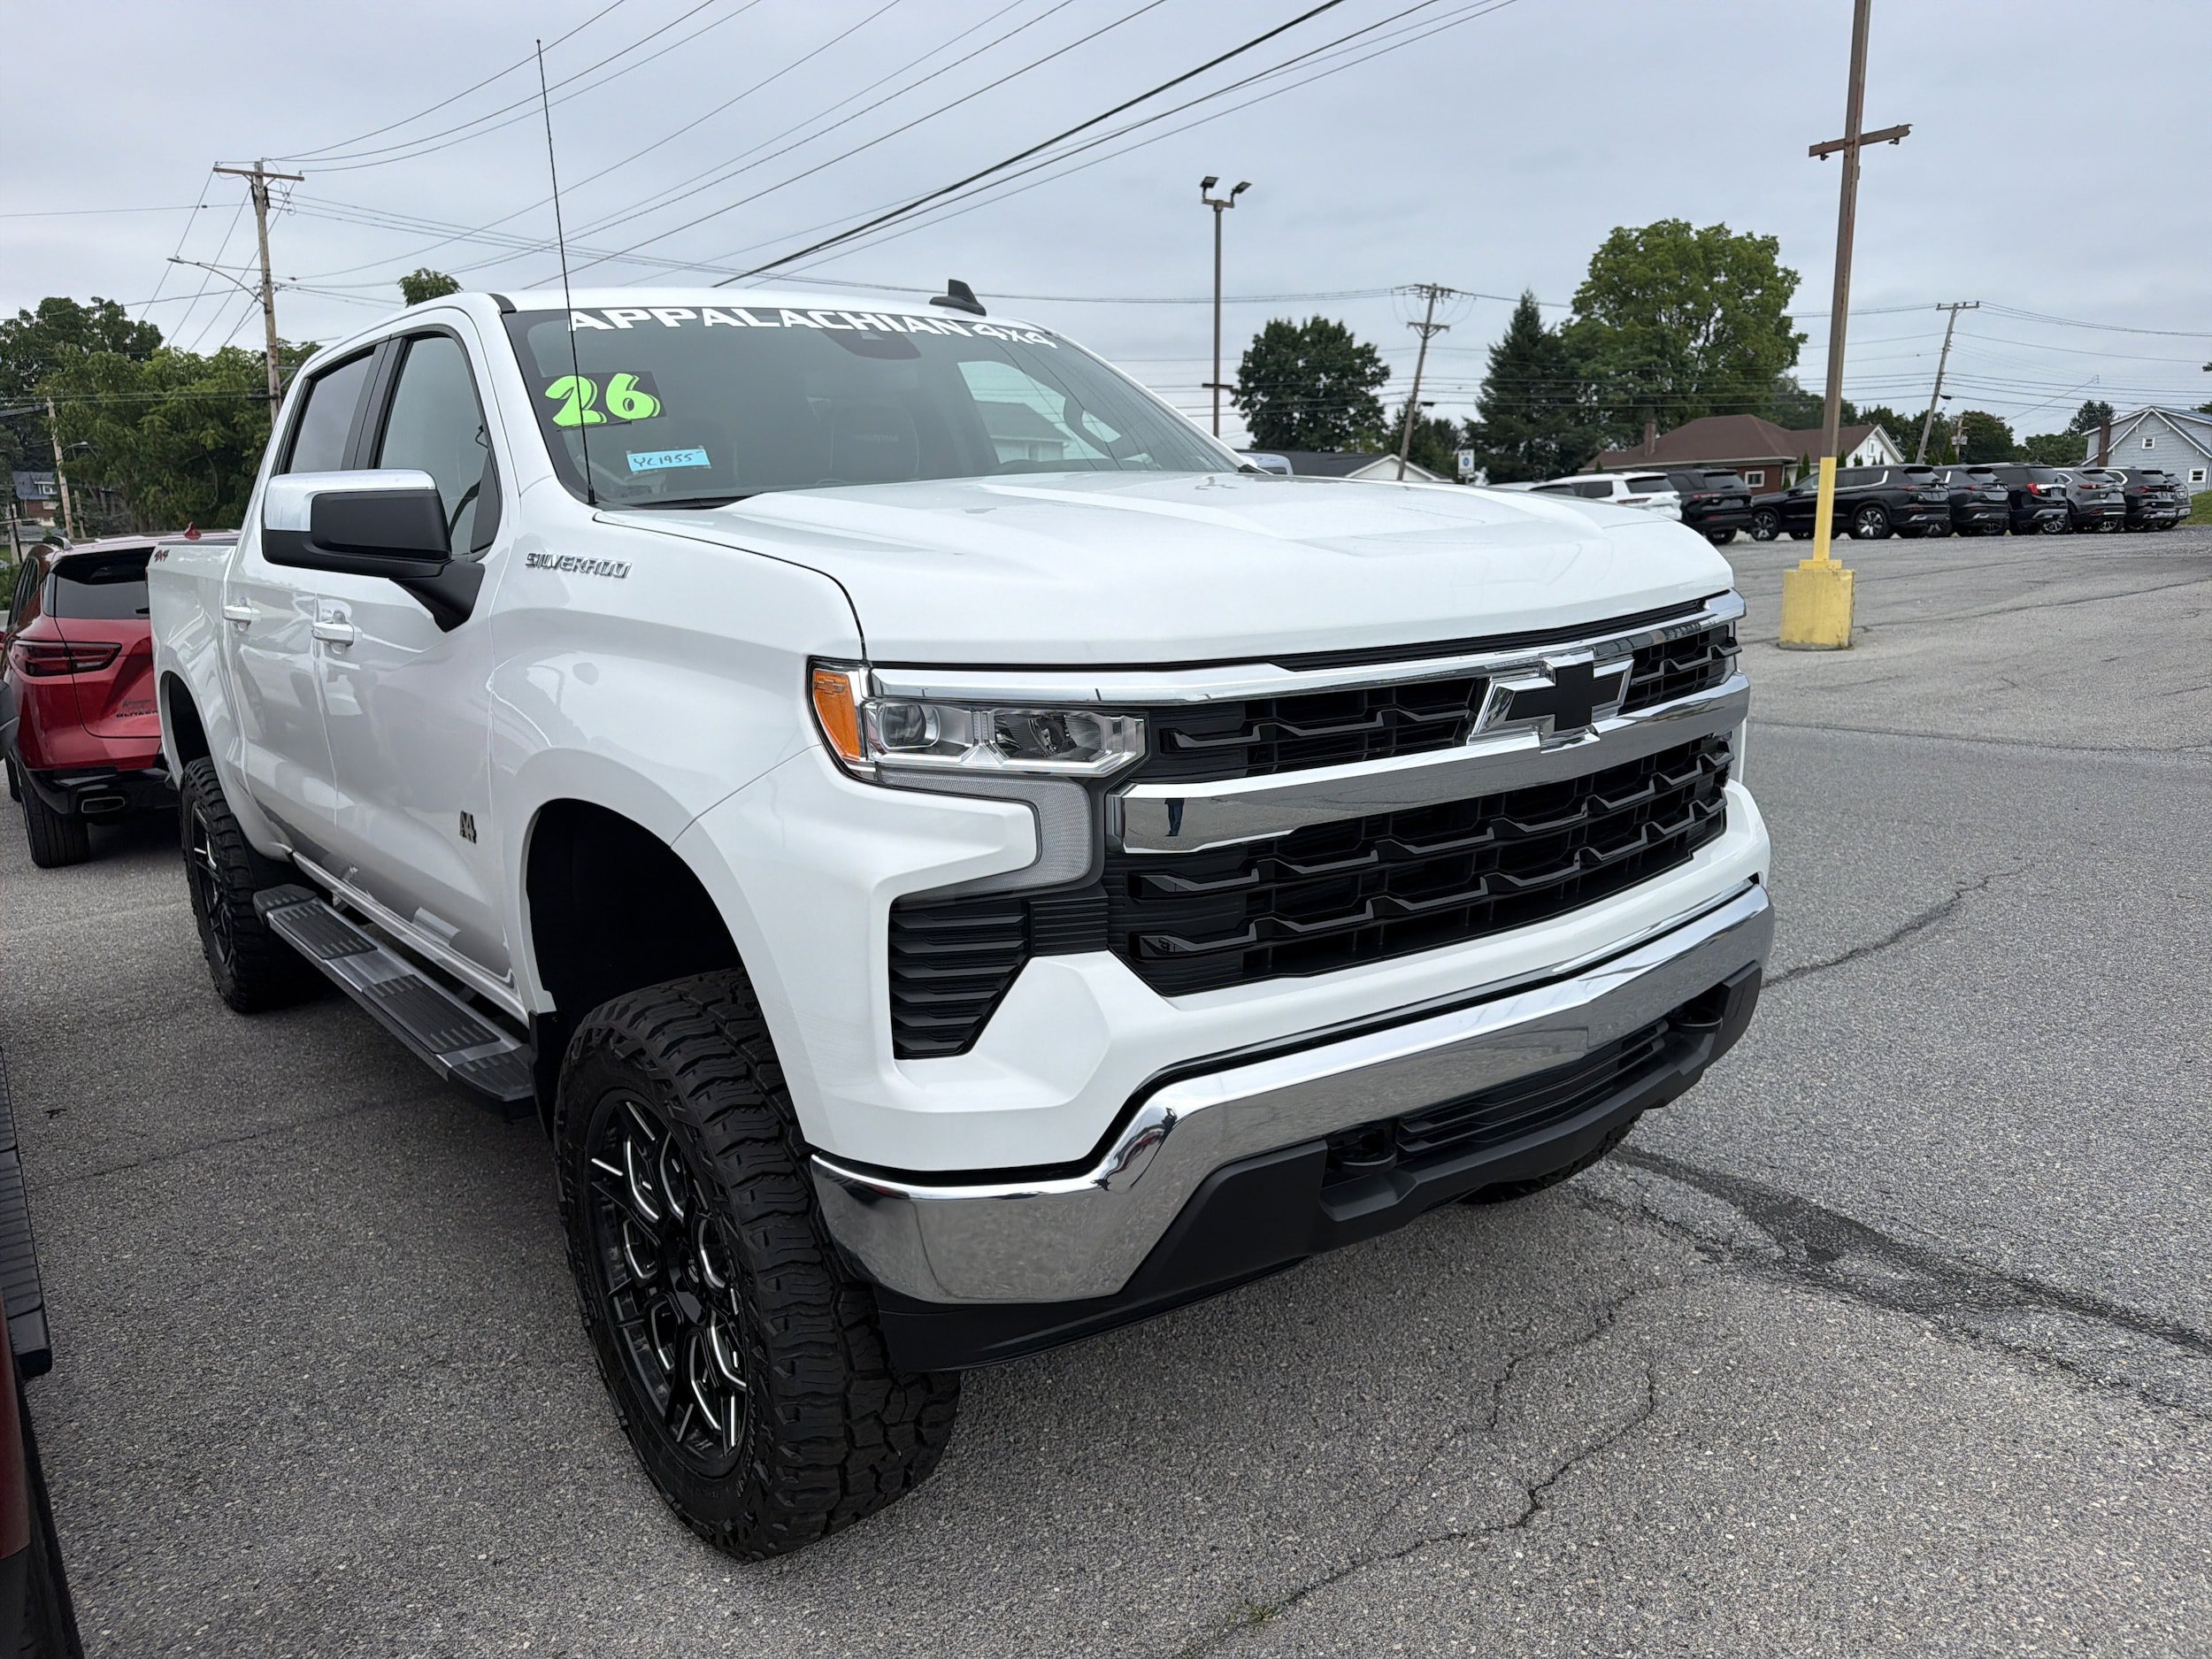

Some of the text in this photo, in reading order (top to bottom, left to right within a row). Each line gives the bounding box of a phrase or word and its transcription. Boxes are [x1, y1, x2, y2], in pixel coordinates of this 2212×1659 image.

[567, 308, 973, 337] APPALACHIAN
[544, 373, 661, 426] 26
[633, 452, 695, 467] YC1955
[525, 552, 632, 579] SILVERADO
